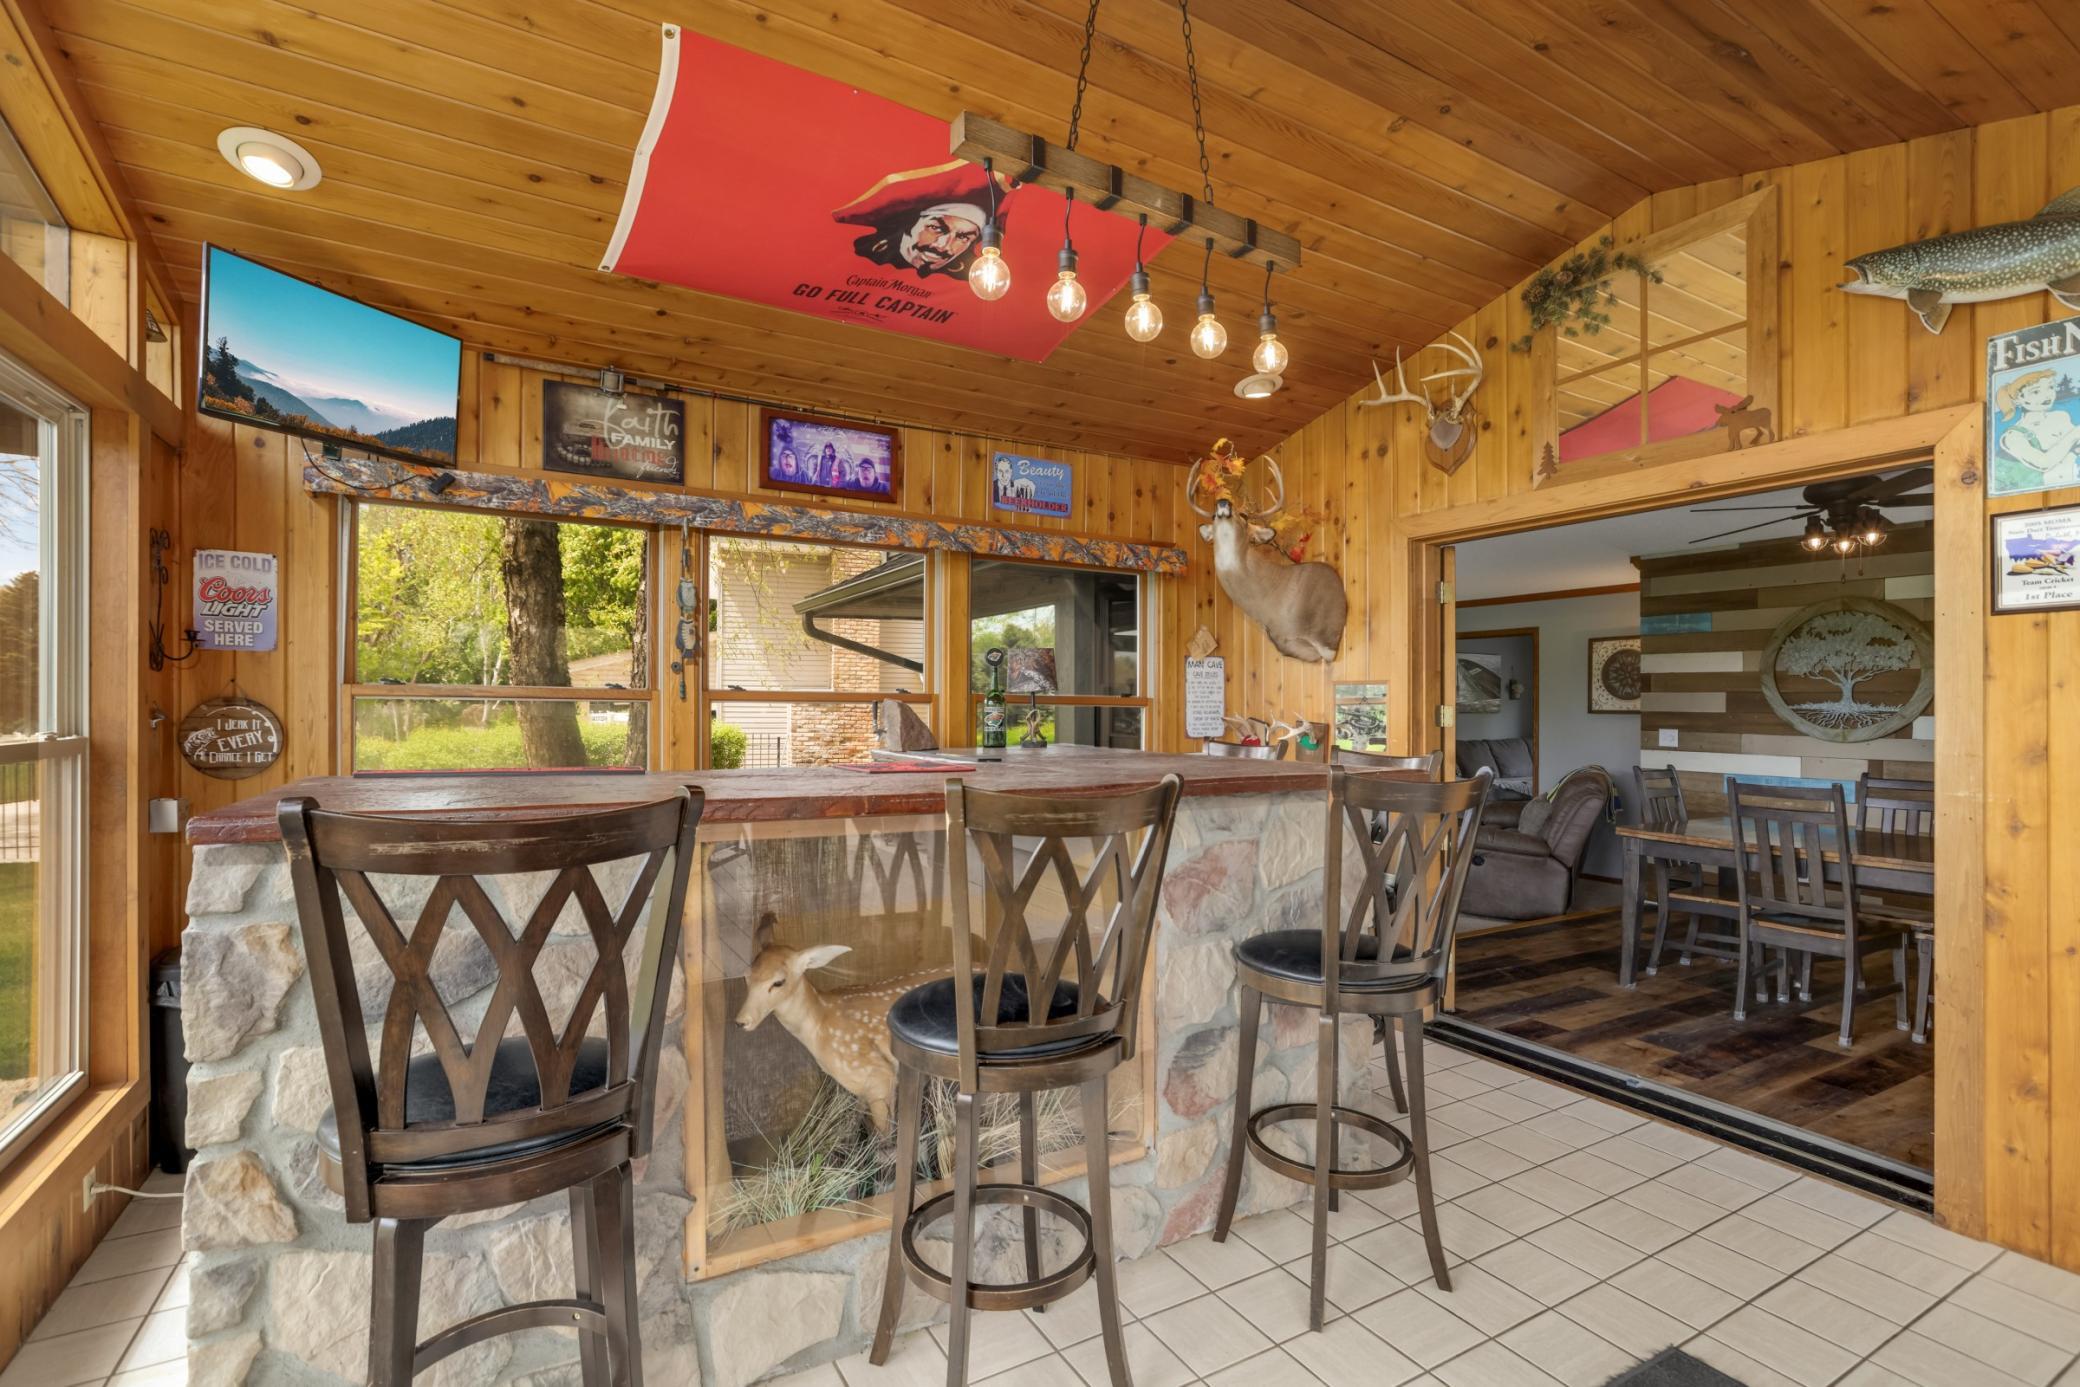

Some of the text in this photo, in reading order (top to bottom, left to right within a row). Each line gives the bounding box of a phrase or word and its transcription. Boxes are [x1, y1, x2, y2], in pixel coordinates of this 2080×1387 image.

[846, 274, 932, 299] Captain Morgan
[792, 283, 825, 299] GO
[826, 289, 870, 306] FULL
[873, 296, 956, 324] CAPTAIN
[610, 432, 677, 450] FAMILY
[1017, 460, 1064, 481] Beauty
[198, 553, 273, 573] ICE COLD
[198, 575, 273, 605] Coors
[200, 601, 269, 618] LIGHT
[203, 620, 264, 634] SERVED
[214, 633, 254, 647] HERE
[1187, 660, 1223, 669] MAN CAVE
[217, 730, 263, 752] EVERY
